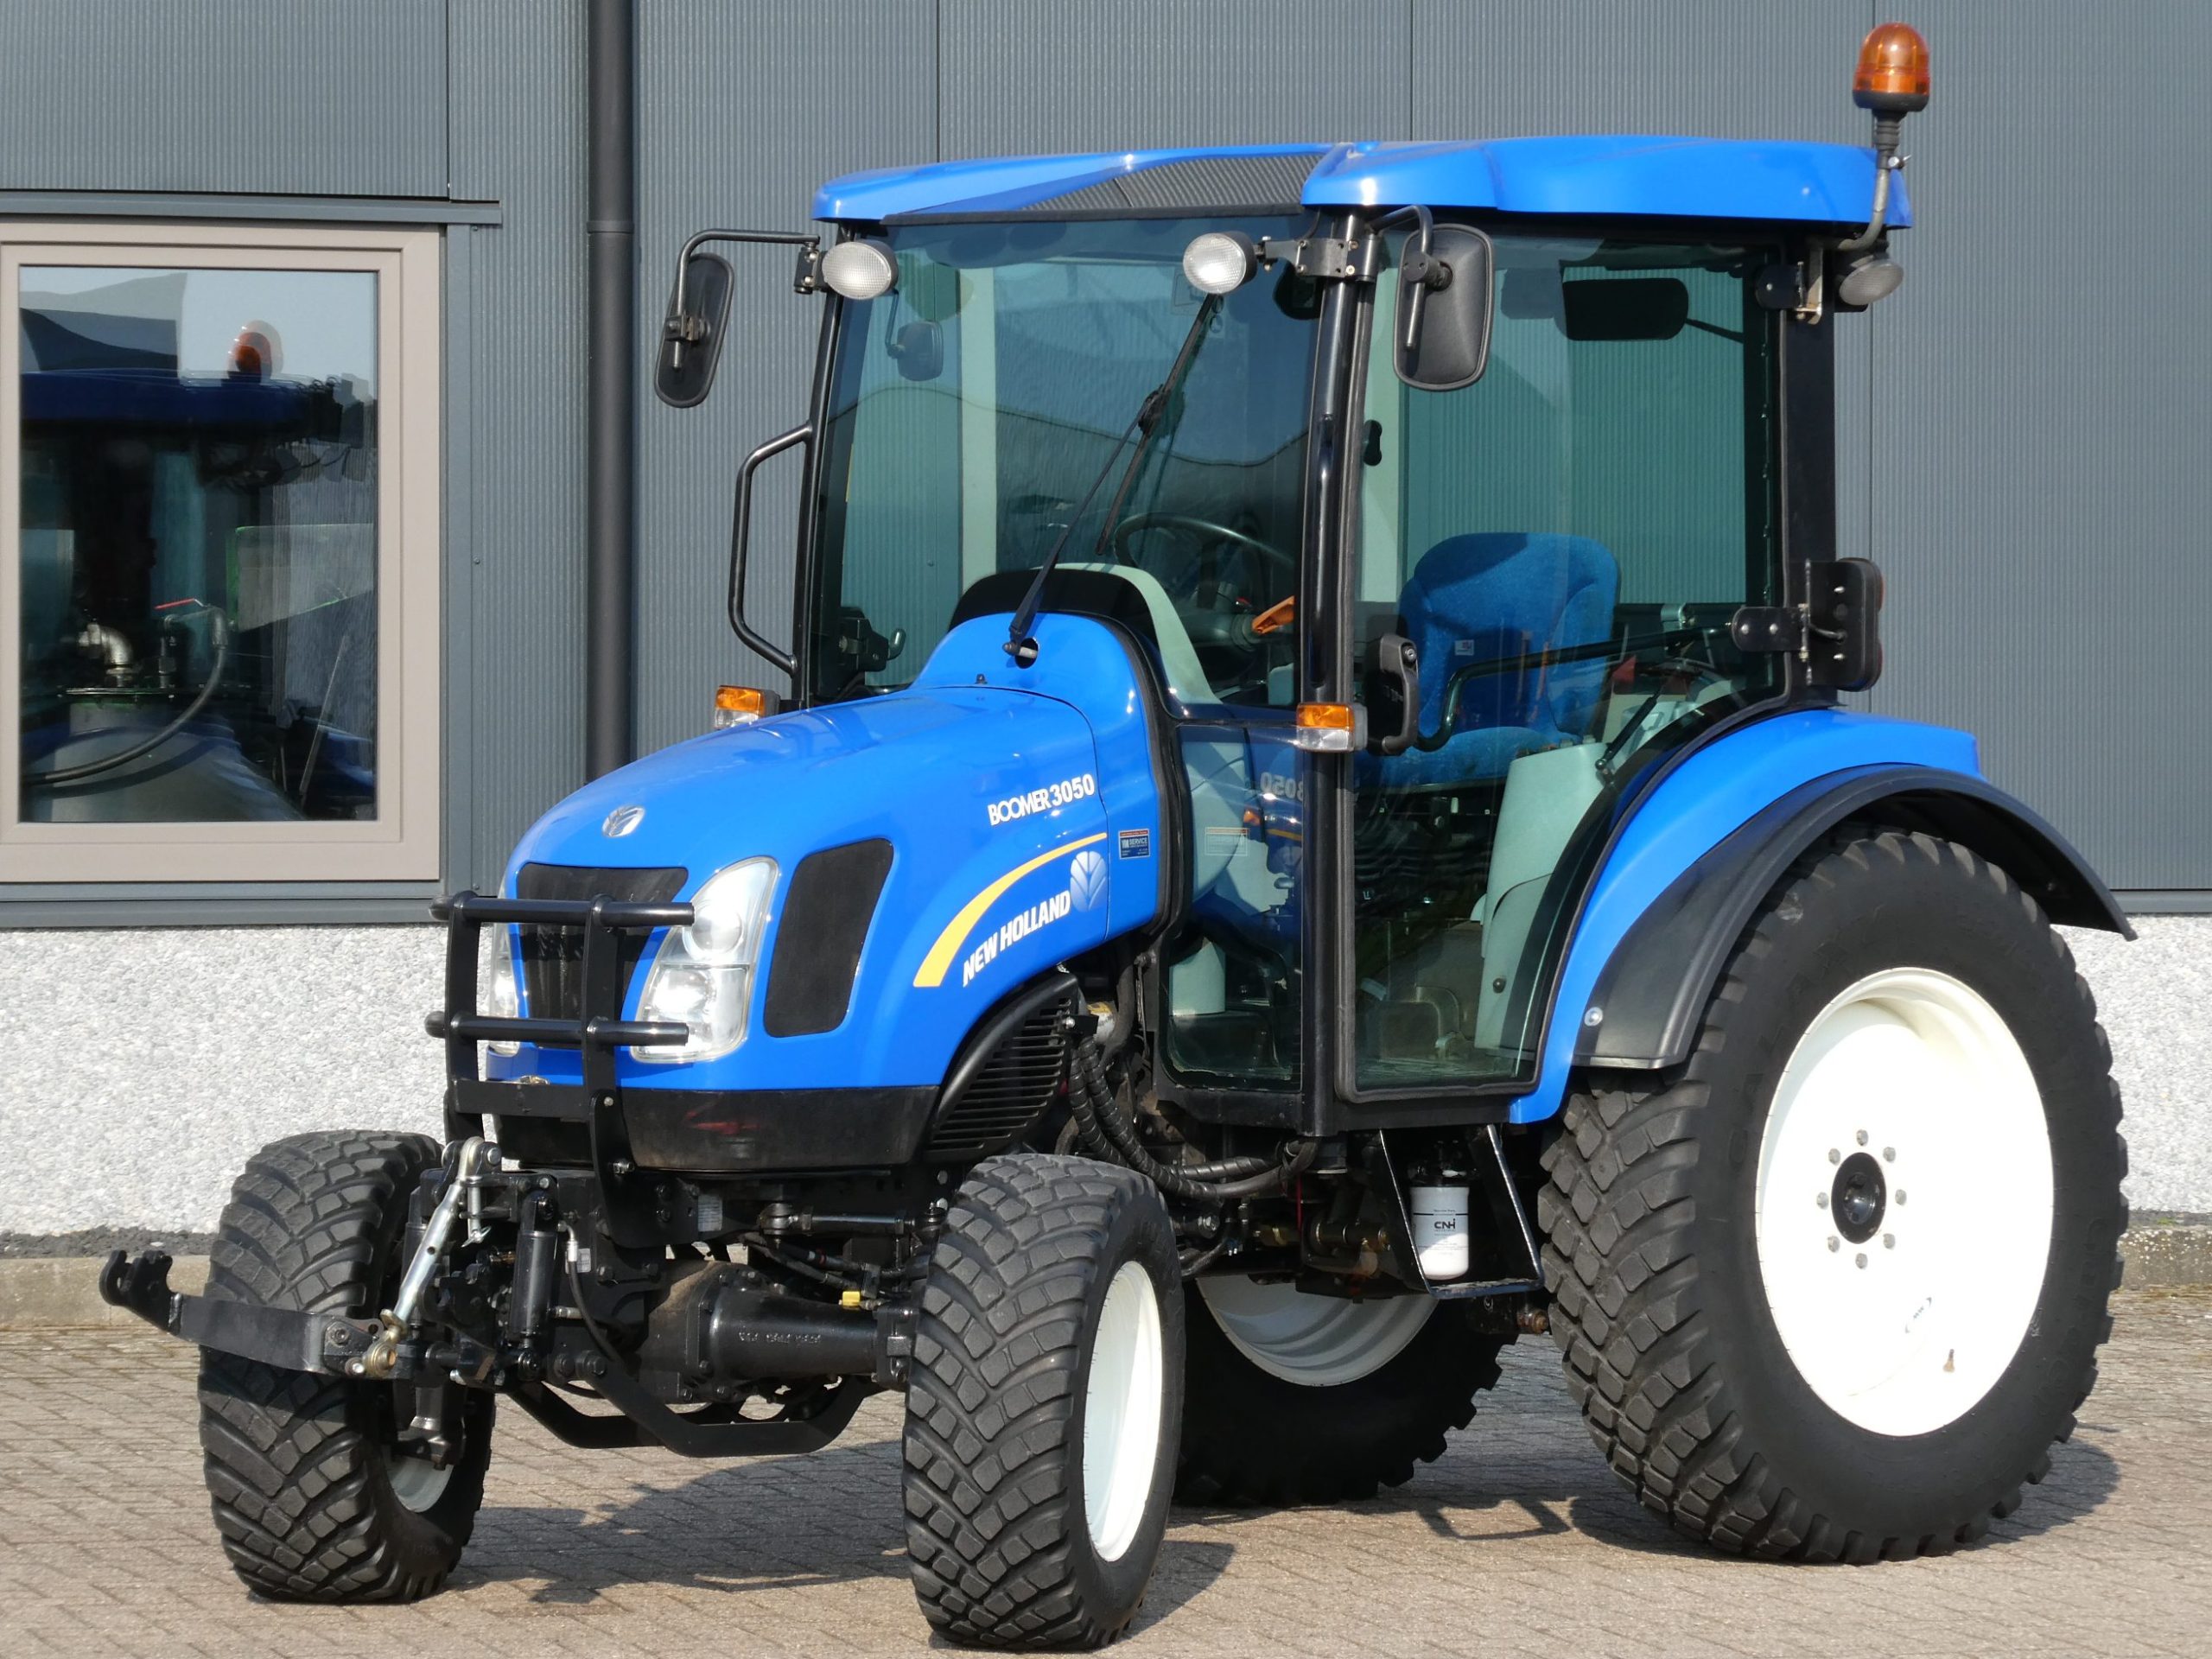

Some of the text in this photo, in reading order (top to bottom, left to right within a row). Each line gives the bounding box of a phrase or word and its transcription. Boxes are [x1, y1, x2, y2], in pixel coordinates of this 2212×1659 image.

[988, 773, 1095, 826] BOOMER 3050
[963, 890, 1071, 988] NEW HOLLAND
